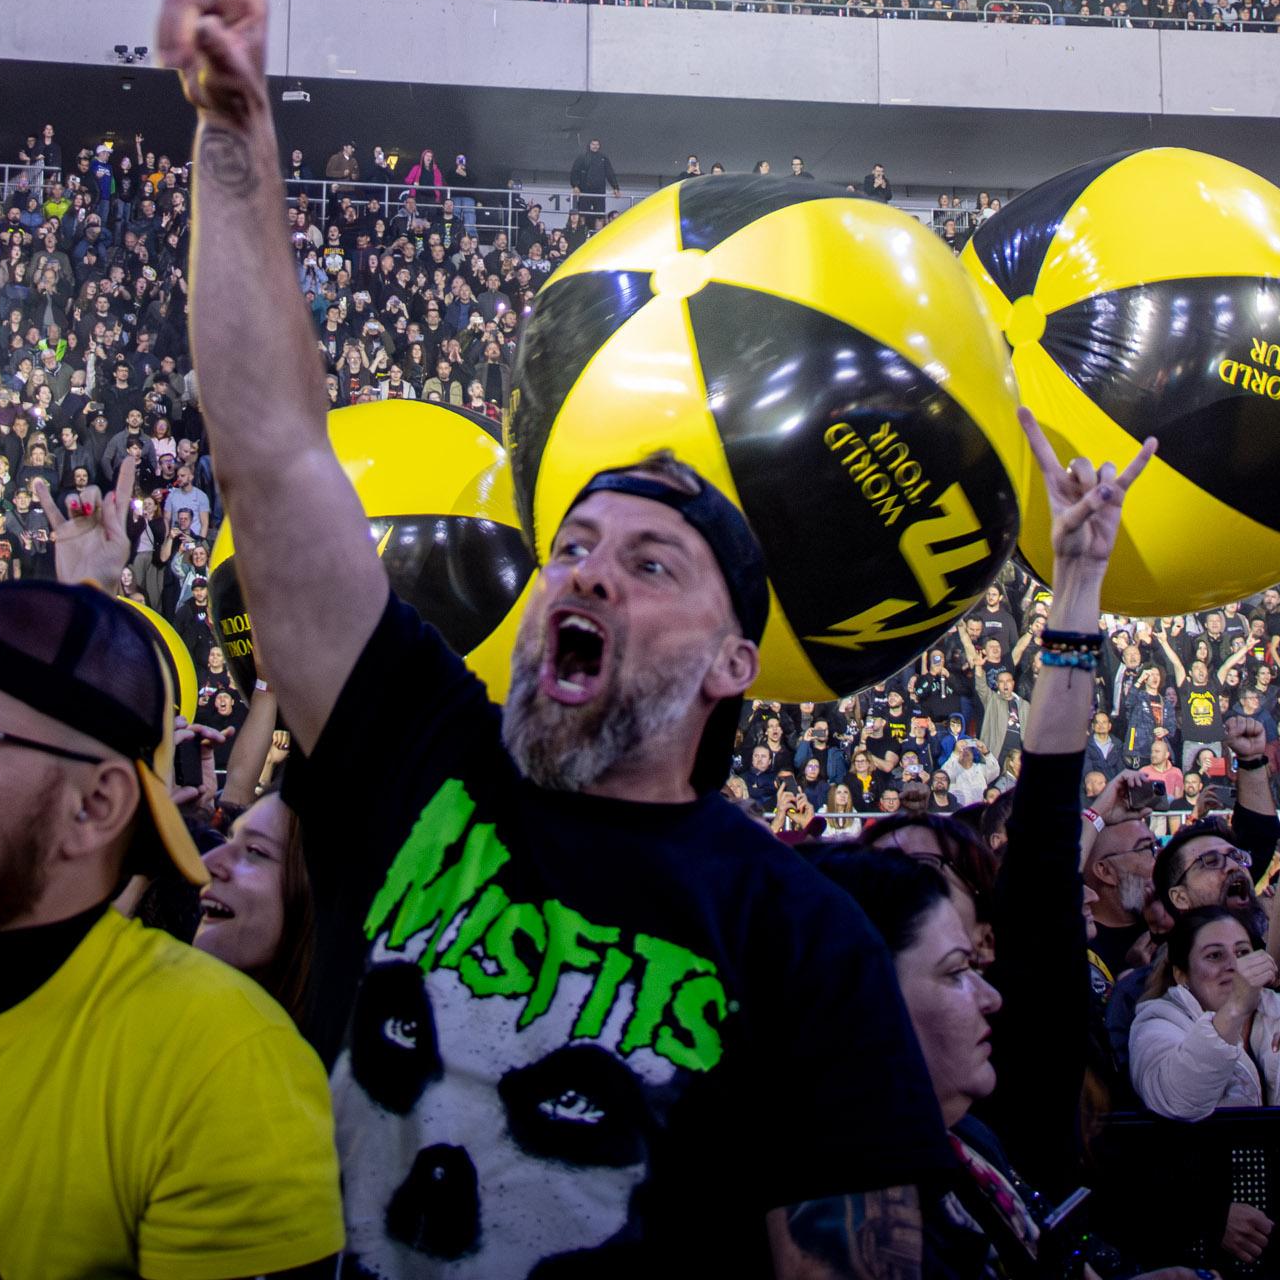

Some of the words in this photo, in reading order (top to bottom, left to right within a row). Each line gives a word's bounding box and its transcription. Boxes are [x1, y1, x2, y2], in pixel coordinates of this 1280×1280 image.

[823, 422, 906, 527] WORLD
[869, 421, 931, 505] TOUR
[363, 778, 728, 1073] MISFITS
